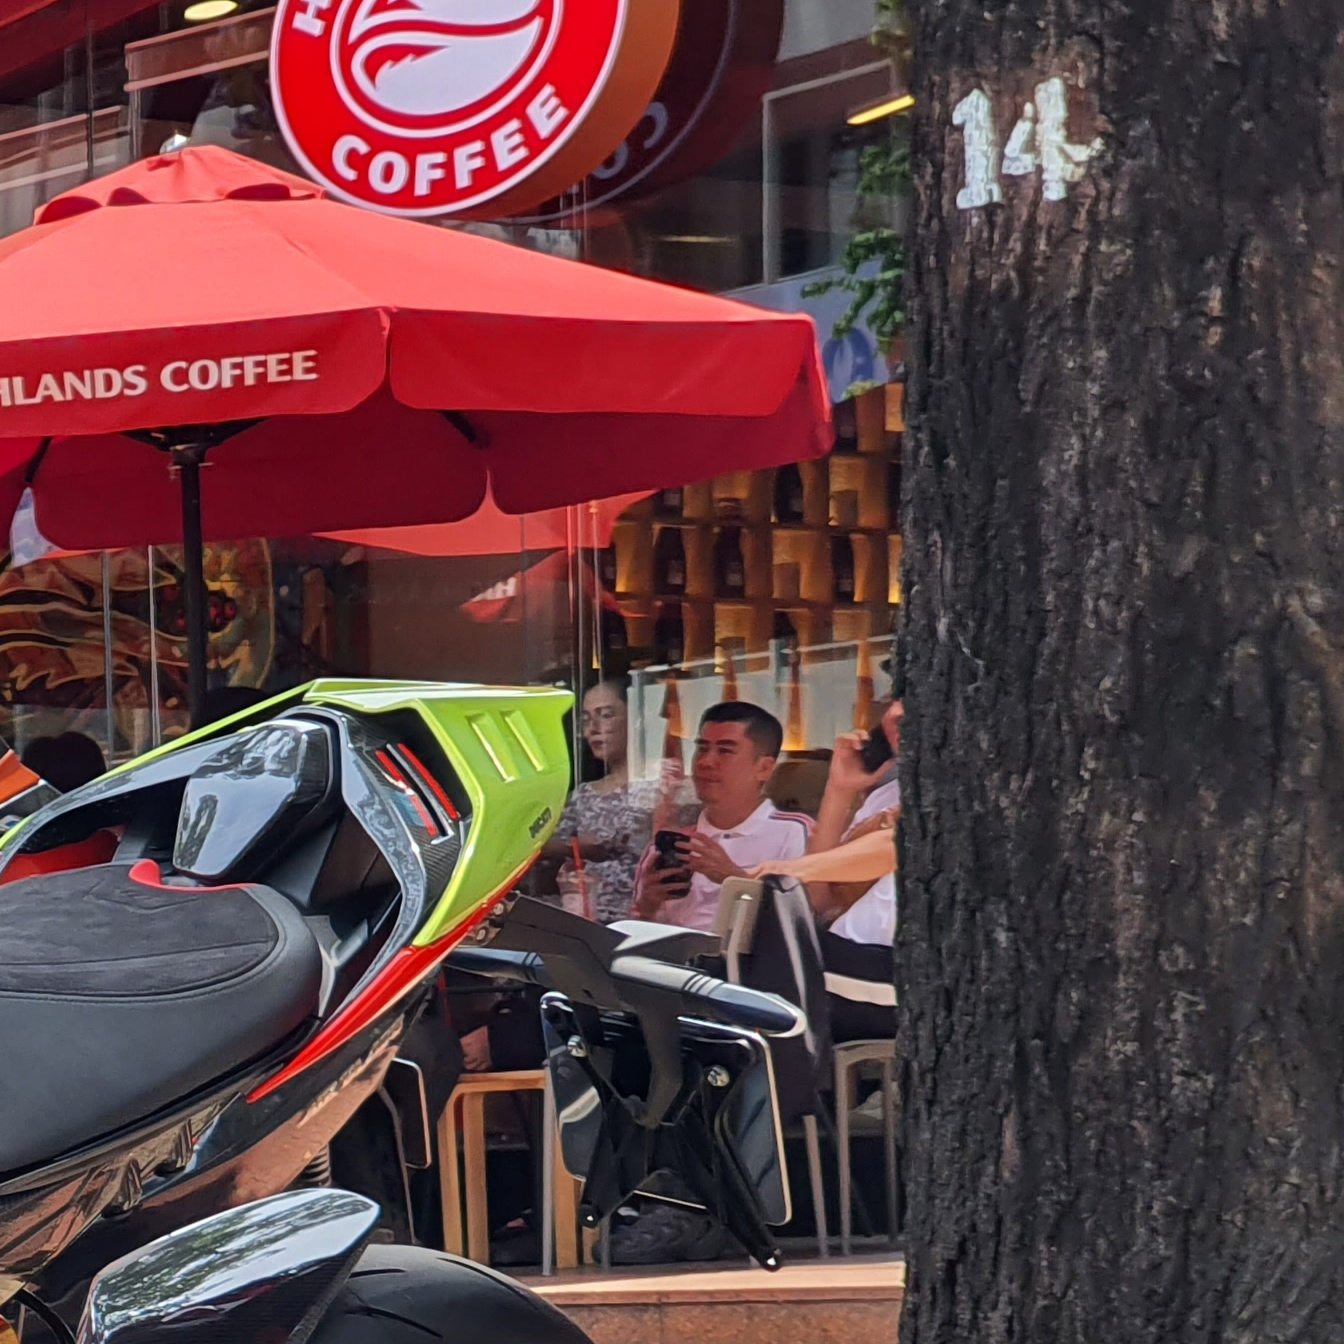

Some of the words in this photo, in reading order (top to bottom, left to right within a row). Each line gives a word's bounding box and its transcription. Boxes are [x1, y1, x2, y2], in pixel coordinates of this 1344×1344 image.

[332, 83, 569, 196] COFFEE
[952, 77, 1106, 209] 14
[160, 349, 320, 392] COFFEE
